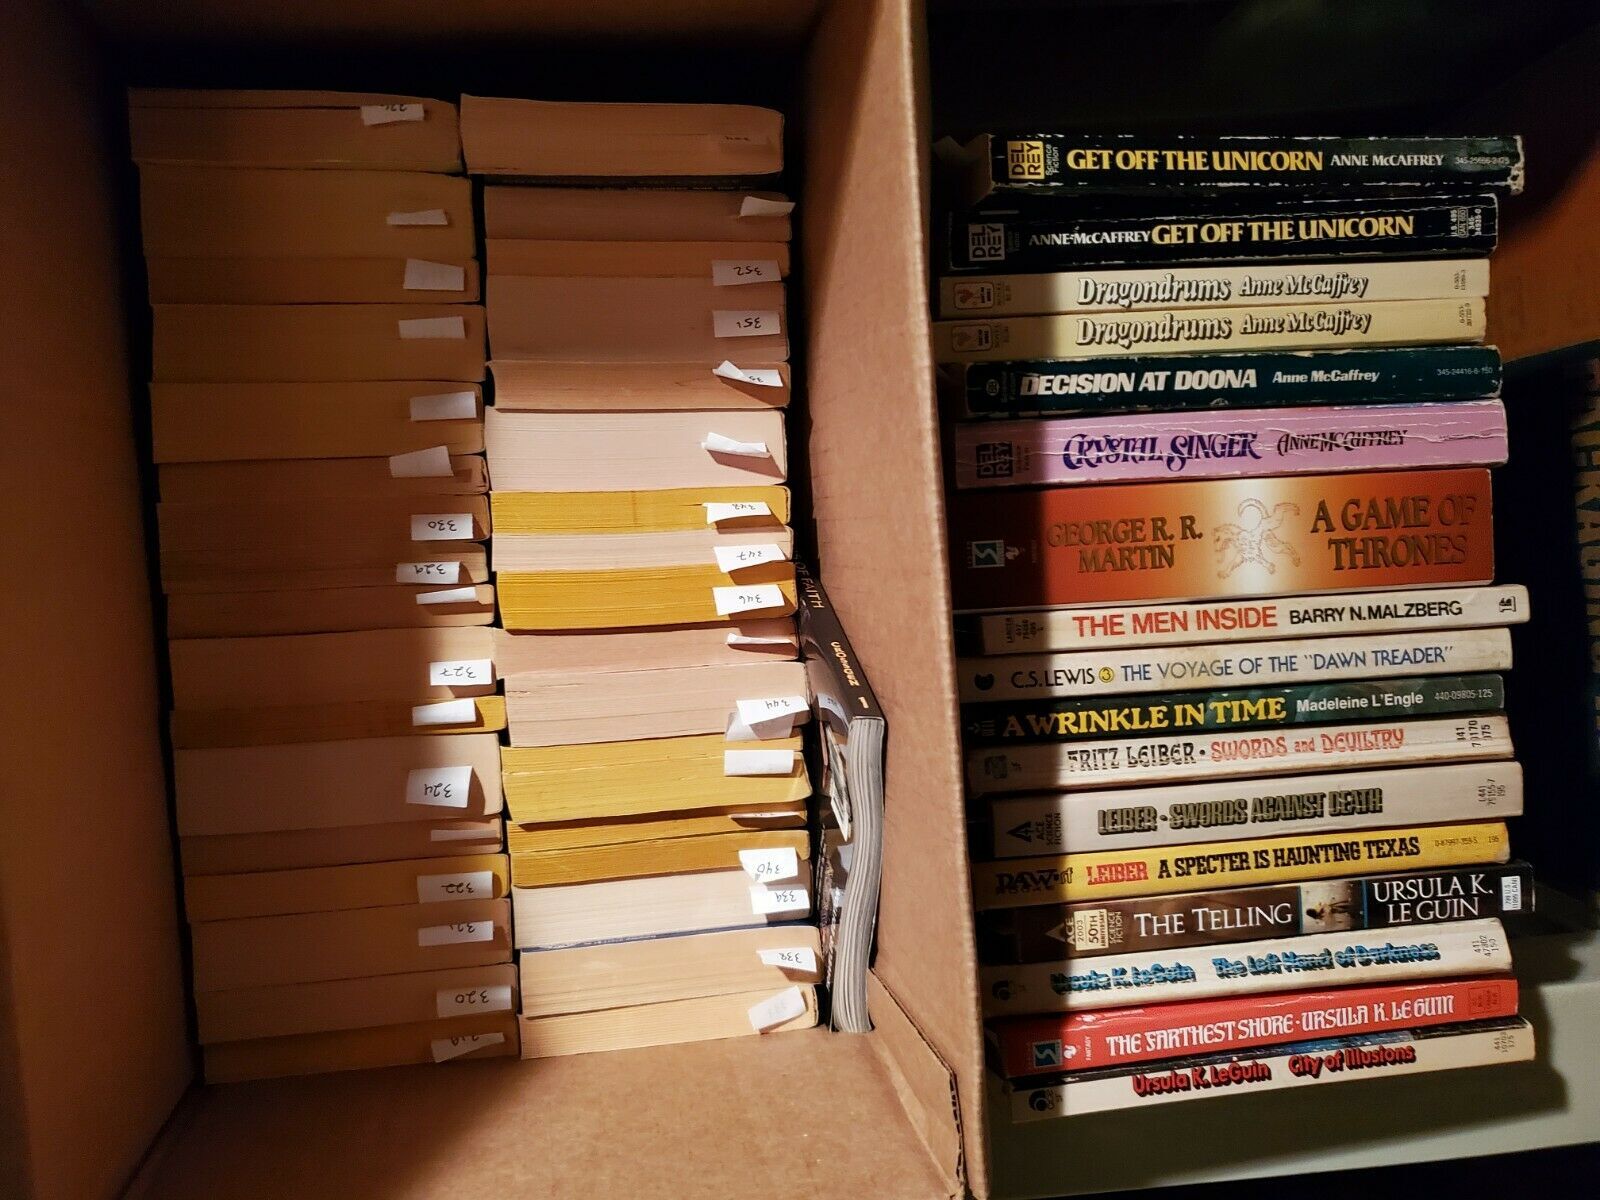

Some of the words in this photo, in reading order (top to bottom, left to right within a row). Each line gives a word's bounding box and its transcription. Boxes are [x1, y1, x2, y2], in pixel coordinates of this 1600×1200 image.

[1011, 143, 1025, 175] DEL
[1026, 143, 1041, 175] REY
[1066, 150, 1114, 170] GET
[1115, 150, 1162, 170] OFF
[1162, 151, 1209, 170] THE
[1212, 151, 1323, 171] UNICORN
[1330, 154, 1369, 166] ANNE
[1372, 154, 1445, 167] McCAFFREY
[1029, 233, 1070, 245] ANNE
[1073, 231, 1150, 245] McCAFFREY
[1151, 223, 1198, 244] GET
[1201, 223, 1244, 243] OFF
[1246, 220, 1295, 241] THE
[1299, 215, 1415, 238] UNICORN
[733, 265, 762, 276] 352
[1076, 274, 1232, 308] Dragondrums
[1238, 274, 1284, 297] Anne
[1285, 271, 1369, 298] McCaffrey
[1076, 314, 1233, 349] Dragondrums
[1239, 313, 1284, 334] Anne
[1286, 310, 1371, 336] McCaffrey
[1020, 372, 1135, 397] DECISION
[1138, 371, 1171, 392] AT
[1174, 369, 1257, 391] DOONA
[1272, 371, 1309, 384] Anne
[1310, 370, 1381, 384] McCaffrey
[1063, 433, 1164, 470] CRYSTAL
[1165, 432, 1262, 473] SINGER
[1277, 432, 1318, 457] ANNE
[428, 519, 458, 532] 330
[1310, 499, 1336, 534] A
[1340, 496, 1430, 532] GAME
[1437, 493, 1479, 527] OF
[1047, 517, 1147, 548] GEORGE
[1151, 516, 1175, 542] R.
[1180, 515, 1203, 541] R.
[735, 551, 762, 561] 347
[1077, 543, 1175, 574] MARTIN
[1328, 534, 1469, 571] THRONES
[413, 563, 447, 575] 329
[803, 578, 825, 609] FAITH
[1072, 613, 1125, 638] THE
[1131, 611, 1189, 634] MEN
[1195, 606, 1278, 631] INSIDE
[1289, 606, 1346, 625] BARRY
[439, 666, 477, 679] 327
[1045, 668, 1095, 687] LEWIS
[1121, 663, 1152, 682] THE
[1157, 659, 1232, 679] VOYAGE
[1238, 657, 1263, 675] OF
[1268, 655, 1298, 673] THE
[1002, 716, 1025, 737] A
[1027, 706, 1168, 737] WRINKLE
[1173, 703, 1205, 727] IN
[1209, 697, 1287, 723] TIME
[1296, 698, 1368, 713] Madeleine
[1371, 692, 1424, 710] L'Engle
[1067, 747, 1120, 772] FRITZ
[1125, 742, 1197, 768] LEIBER
[1210, 735, 1288, 763] SWORDS
[1294, 737, 1315, 753] and
[423, 782, 453, 798] 324
[1097, 805, 1157, 835] LEIBER
[1168, 798, 1248, 830] SWORDS
[1250, 791, 1327, 823] AGAINST
[1328, 788, 1383, 816] DEATH
[1053, 812, 1061, 845] FICTION
[1086, 861, 1149, 885] LEIBER
[1158, 859, 1172, 879] A
[1174, 852, 1249, 877] SPECTER
[1253, 851, 1271, 868] IS
[1274, 841, 1361, 866] HAUNTING
[1363, 836, 1421, 858] TEXAS
[1373, 876, 1465, 903] URSULA
[1469, 874, 1494, 895] K.
[1134, 912, 1185, 937] THE
[1192, 903, 1292, 933] TELLING
[1388, 902, 1414, 924] LE
[1416, 897, 1480, 921] GUIN
[1065, 917, 1075, 945] ACE
[1076, 920, 1084, 942] 2003
[1088, 915, 1099, 943] 50TH
[1107, 911, 1116, 944] SCIENCE
[1115, 911, 1124, 944] FICTION
[1212, 957, 1247, 980] The
[1247, 952, 1282, 976] Left
[1281, 948, 1335, 972] Hand
[1335, 945, 1357, 968] of
[1355, 942, 1441, 965] Darkness
[454, 990, 490, 1005] 320
[1106, 1033, 1142, 1057] THE
[1145, 1019, 1237, 1052] FARTHEST
[1237, 1014, 1294, 1039] SHORE
[1301, 1005, 1369, 1031] URSULA
[1373, 1003, 1390, 1023] K.
[1391, 1001, 1412, 1020] LE
[1414, 995, 1455, 1017] GUIN
[1132, 1070, 1189, 1097] Ursula
[1190, 1067, 1209, 1090] K.
[1288, 1055, 1323, 1079] City
[1324, 1051, 1344, 1073] of
[1344, 1045, 1416, 1070] Illusions
